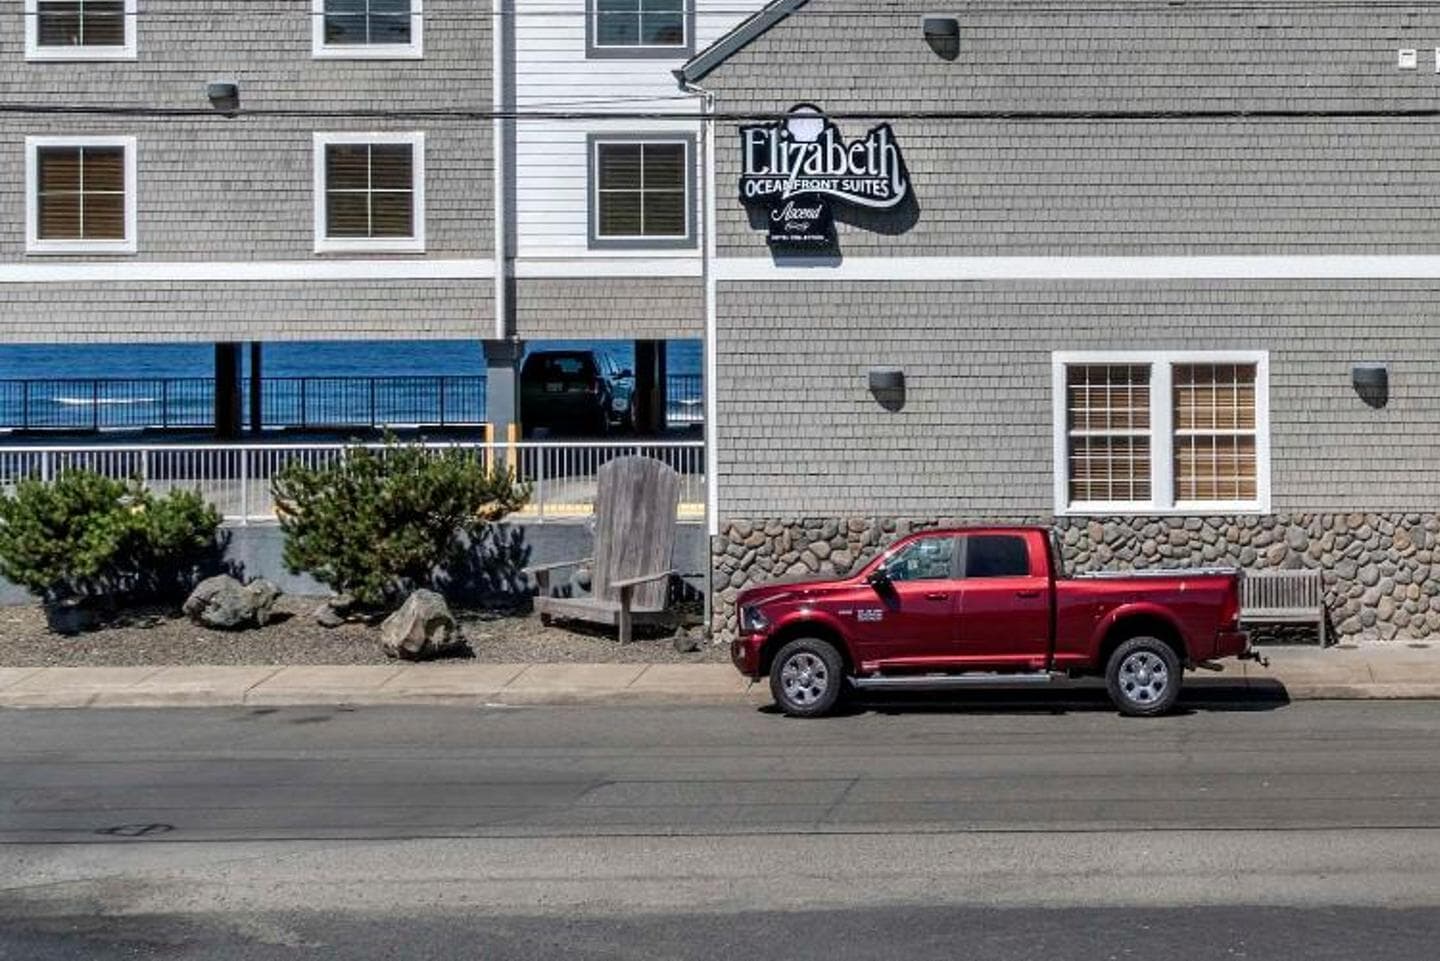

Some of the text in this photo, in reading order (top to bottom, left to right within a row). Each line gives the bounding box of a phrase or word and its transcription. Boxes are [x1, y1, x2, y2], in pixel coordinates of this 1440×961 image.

[744, 127, 906, 199] Elizabeth
[745, 178, 889, 197] OCEANFRONT SUITES
[771, 200, 823, 221] Ascend
